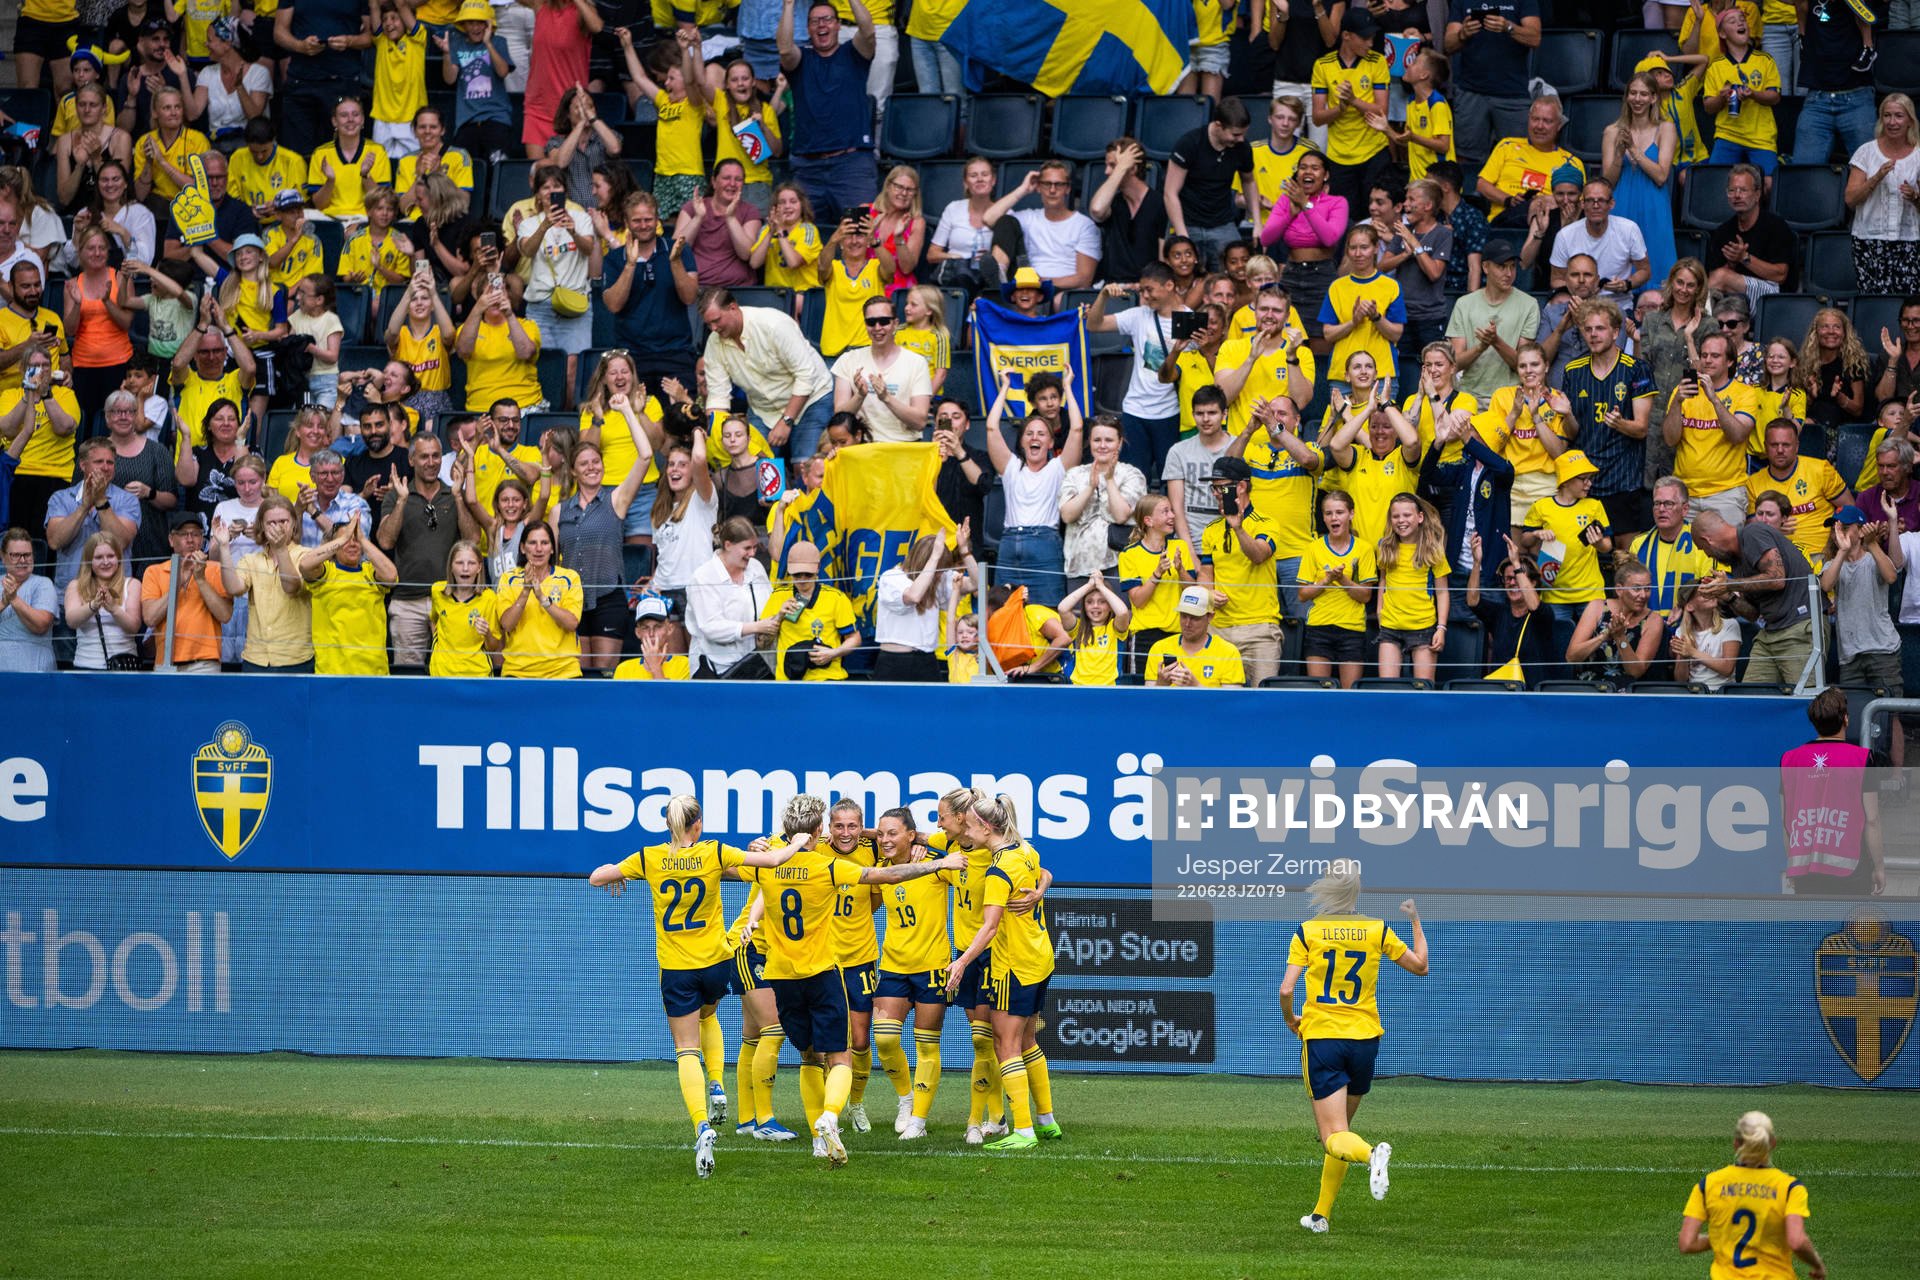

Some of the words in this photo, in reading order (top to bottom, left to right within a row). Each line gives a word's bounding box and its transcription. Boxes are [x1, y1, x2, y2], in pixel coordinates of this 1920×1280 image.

[998, 354, 1058, 368] SVERIGE
[217, 761, 248, 772] SvFF
[418, 741, 1091, 841] Tillsammans
[1108, 752, 1222, 842] är
[1240, 754, 1337, 844] vi
[1357, 758, 1770, 870] Sverige
[661, 856, 703, 871] SCHOUGH
[774, 866, 809, 881] HURTIG
[659, 877, 707, 932] 22
[833, 893, 854, 917] 16
[956, 886, 972, 911] 14
[780, 887, 805, 941] 8
[895, 904, 918, 929] 19
[1055, 911, 1107, 927] Hämta
[1111, 912, 1117, 927] i
[1321, 928, 1368, 942] ILESTEDT
[1054, 930, 1114, 966] App
[1119, 931, 1199, 962] Store
[0, 909, 231, 1013] tboll
[859, 970, 876, 995] 16
[927, 969, 947, 988] 19
[1316, 949, 1367, 1005] 13
[1058, 1017, 1148, 1054] Google
[1151, 1019, 1203, 1055] Play
[1720, 1183, 1778, 1201] ANDERSSON
[1731, 1207, 1757, 1269] 2
